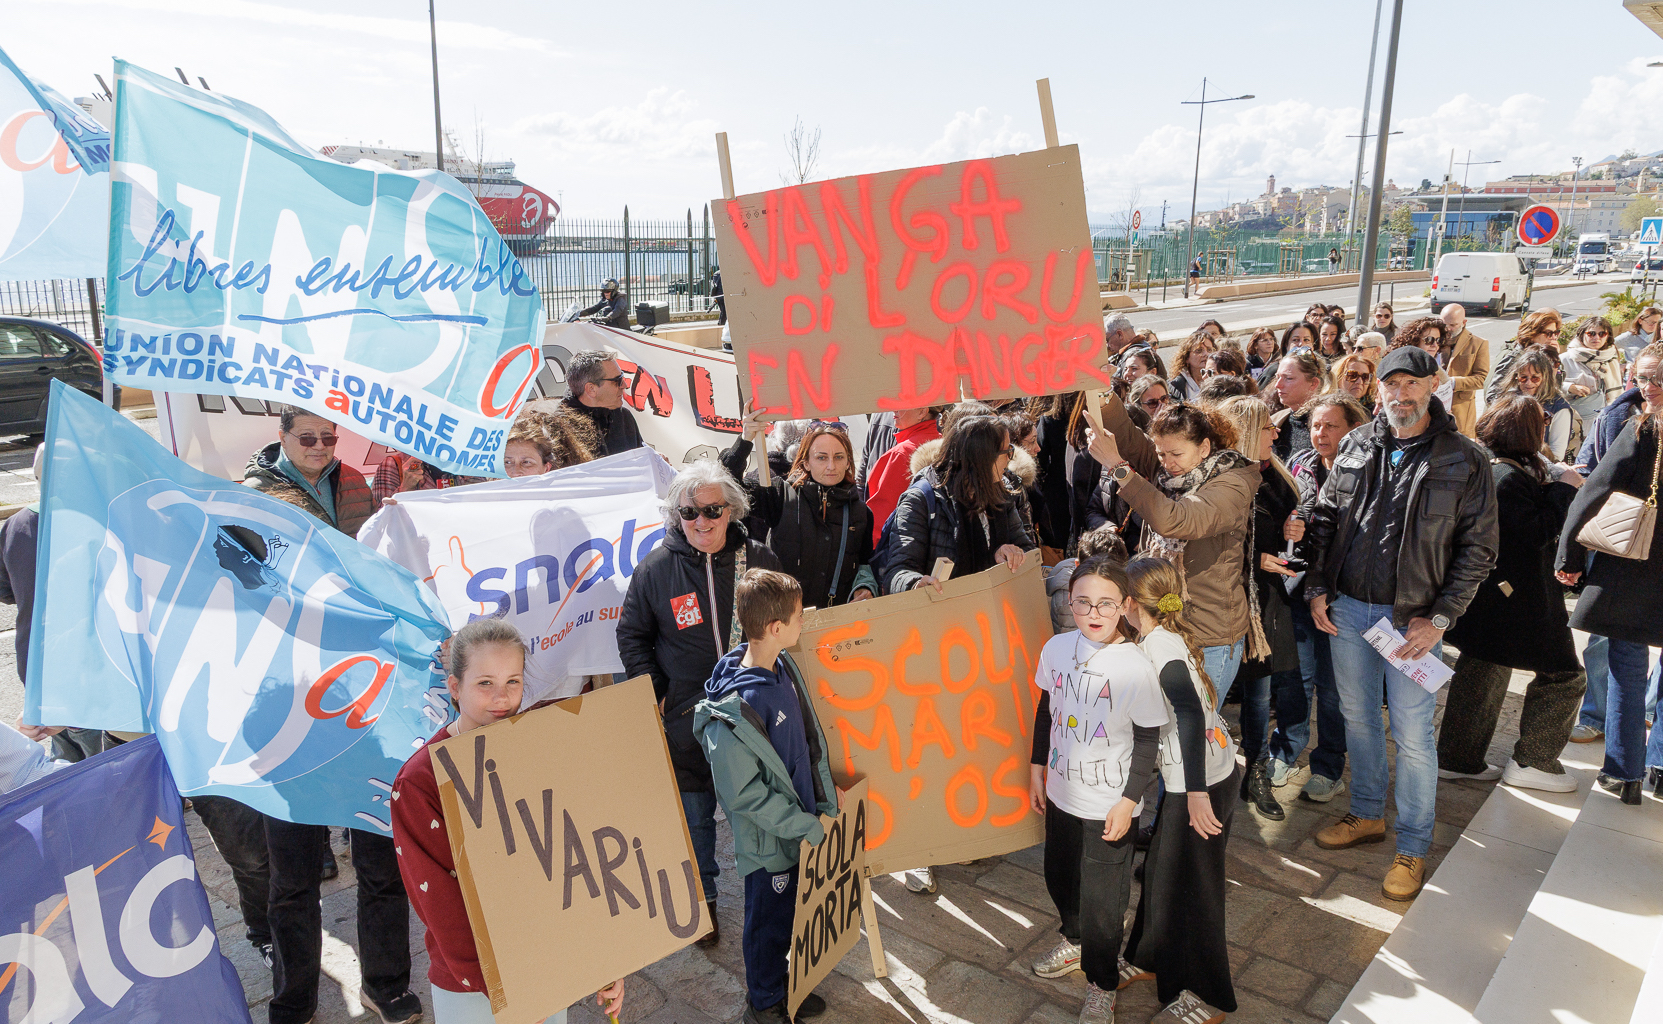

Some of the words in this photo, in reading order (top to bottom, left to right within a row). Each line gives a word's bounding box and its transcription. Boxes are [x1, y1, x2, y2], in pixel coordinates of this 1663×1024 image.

[118, 208, 271, 297] libres
[294, 236, 536, 299] ensemble
[727, 158, 1022, 287] VANGA
[864, 248, 1093, 329] L'ORU
[748, 343, 840, 417] EN
[877, 324, 1110, 409] DANGER
[466, 427, 503, 451] DES
[576, 610, 594, 627] au
[676, 606, 702, 626] cgt
[817, 600, 1032, 711] SCOLA
[802, 799, 865, 905] SCOLA
[793, 869, 862, 994] MORTA
